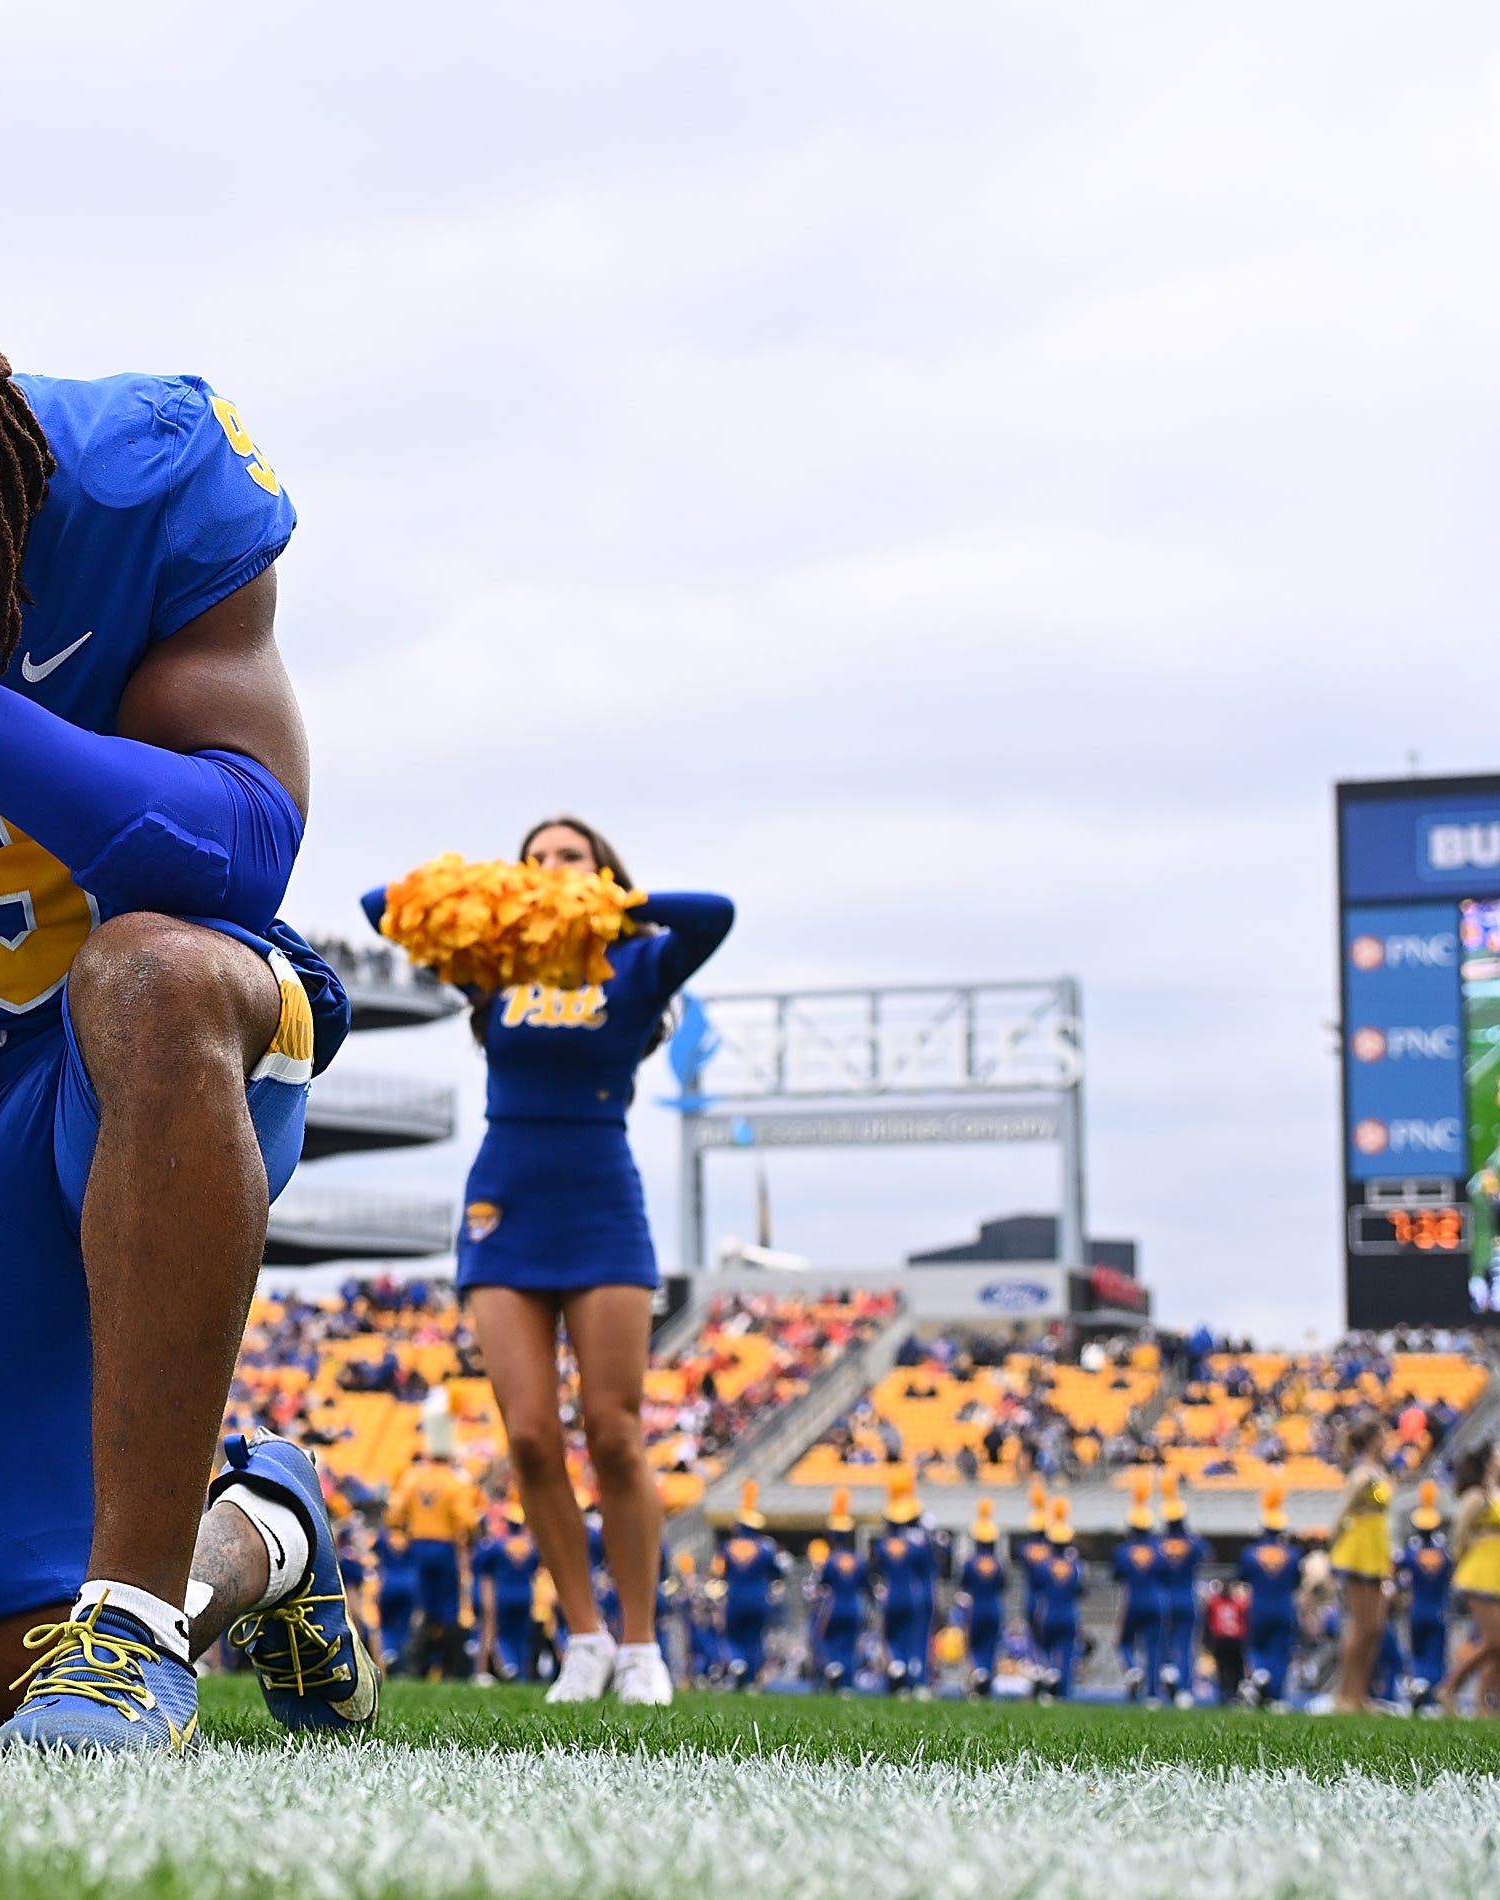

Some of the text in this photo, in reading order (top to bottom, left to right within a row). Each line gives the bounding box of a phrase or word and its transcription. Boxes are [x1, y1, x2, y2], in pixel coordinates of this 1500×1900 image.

[208, 395, 281, 497] 9
[1385, 931, 1457, 969] PNC
[1386, 1024, 1460, 1061] PNC
[1388, 1116, 1461, 1153] PNC
